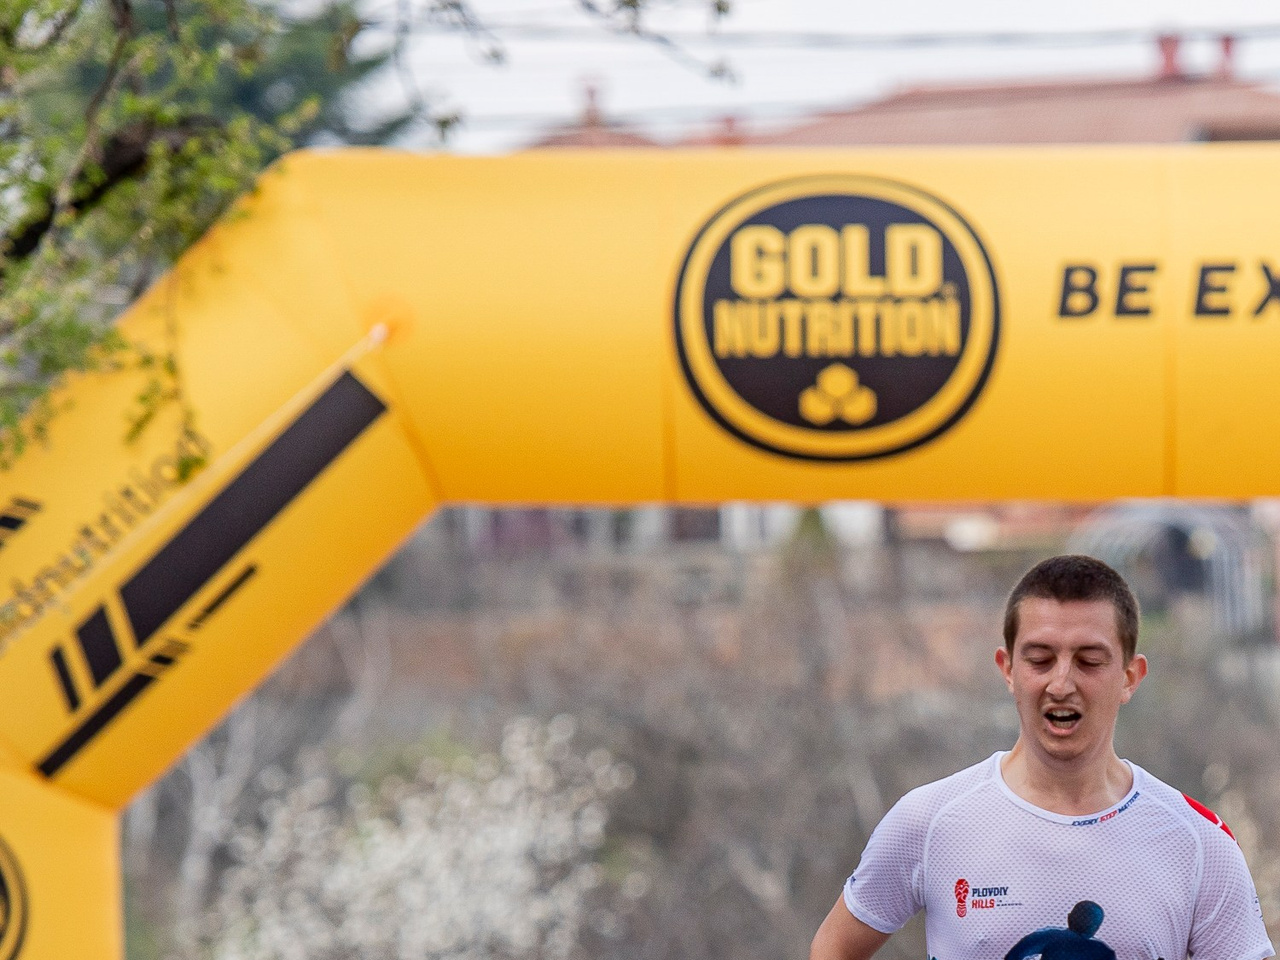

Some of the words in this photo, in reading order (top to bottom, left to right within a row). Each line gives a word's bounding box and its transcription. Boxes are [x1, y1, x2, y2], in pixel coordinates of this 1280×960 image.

[730, 223, 943, 299] GOLD
[1057, 263, 1158, 318] BE
[713, 299, 962, 359] NUTRITION
[971, 886, 1009, 898] PLOVDIV
[971, 898, 996, 909] HILLS
